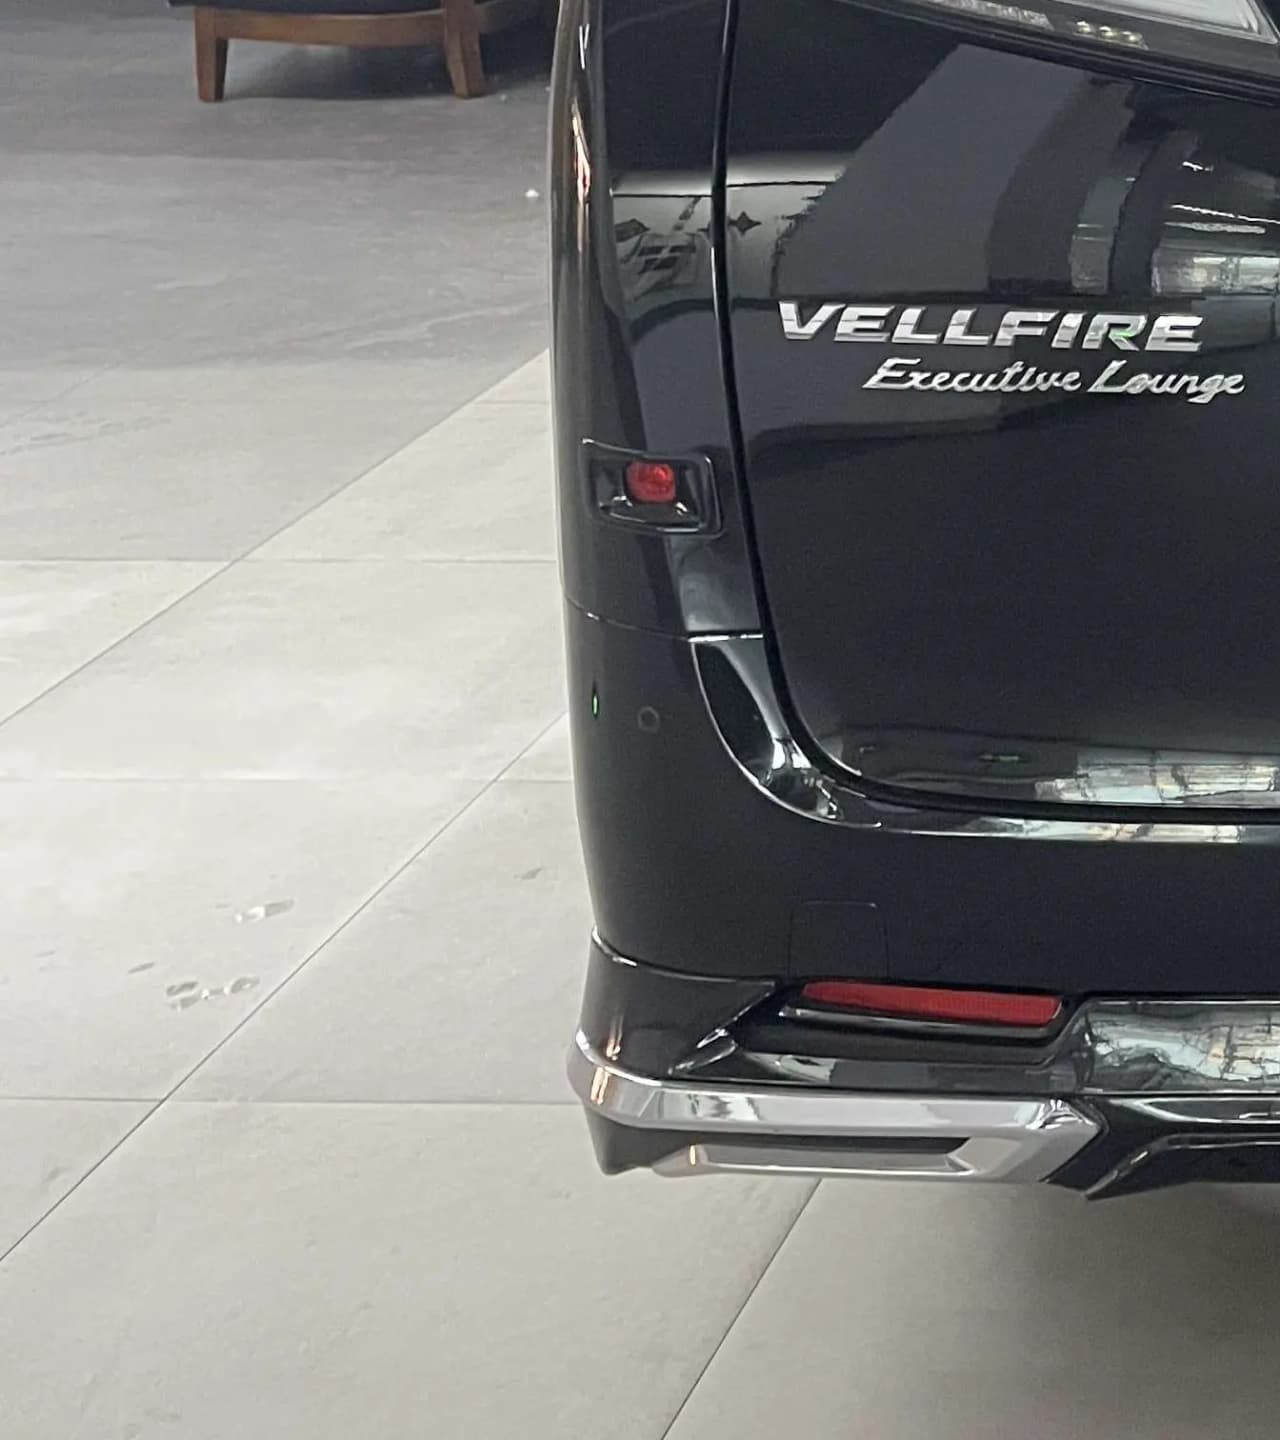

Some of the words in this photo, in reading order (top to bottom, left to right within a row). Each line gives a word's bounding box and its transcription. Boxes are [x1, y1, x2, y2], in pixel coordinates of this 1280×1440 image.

[778, 300, 1204, 352] VELLFIRE
[861, 357, 1082, 393] Executive
[1086, 359, 1247, 404] Lounge
